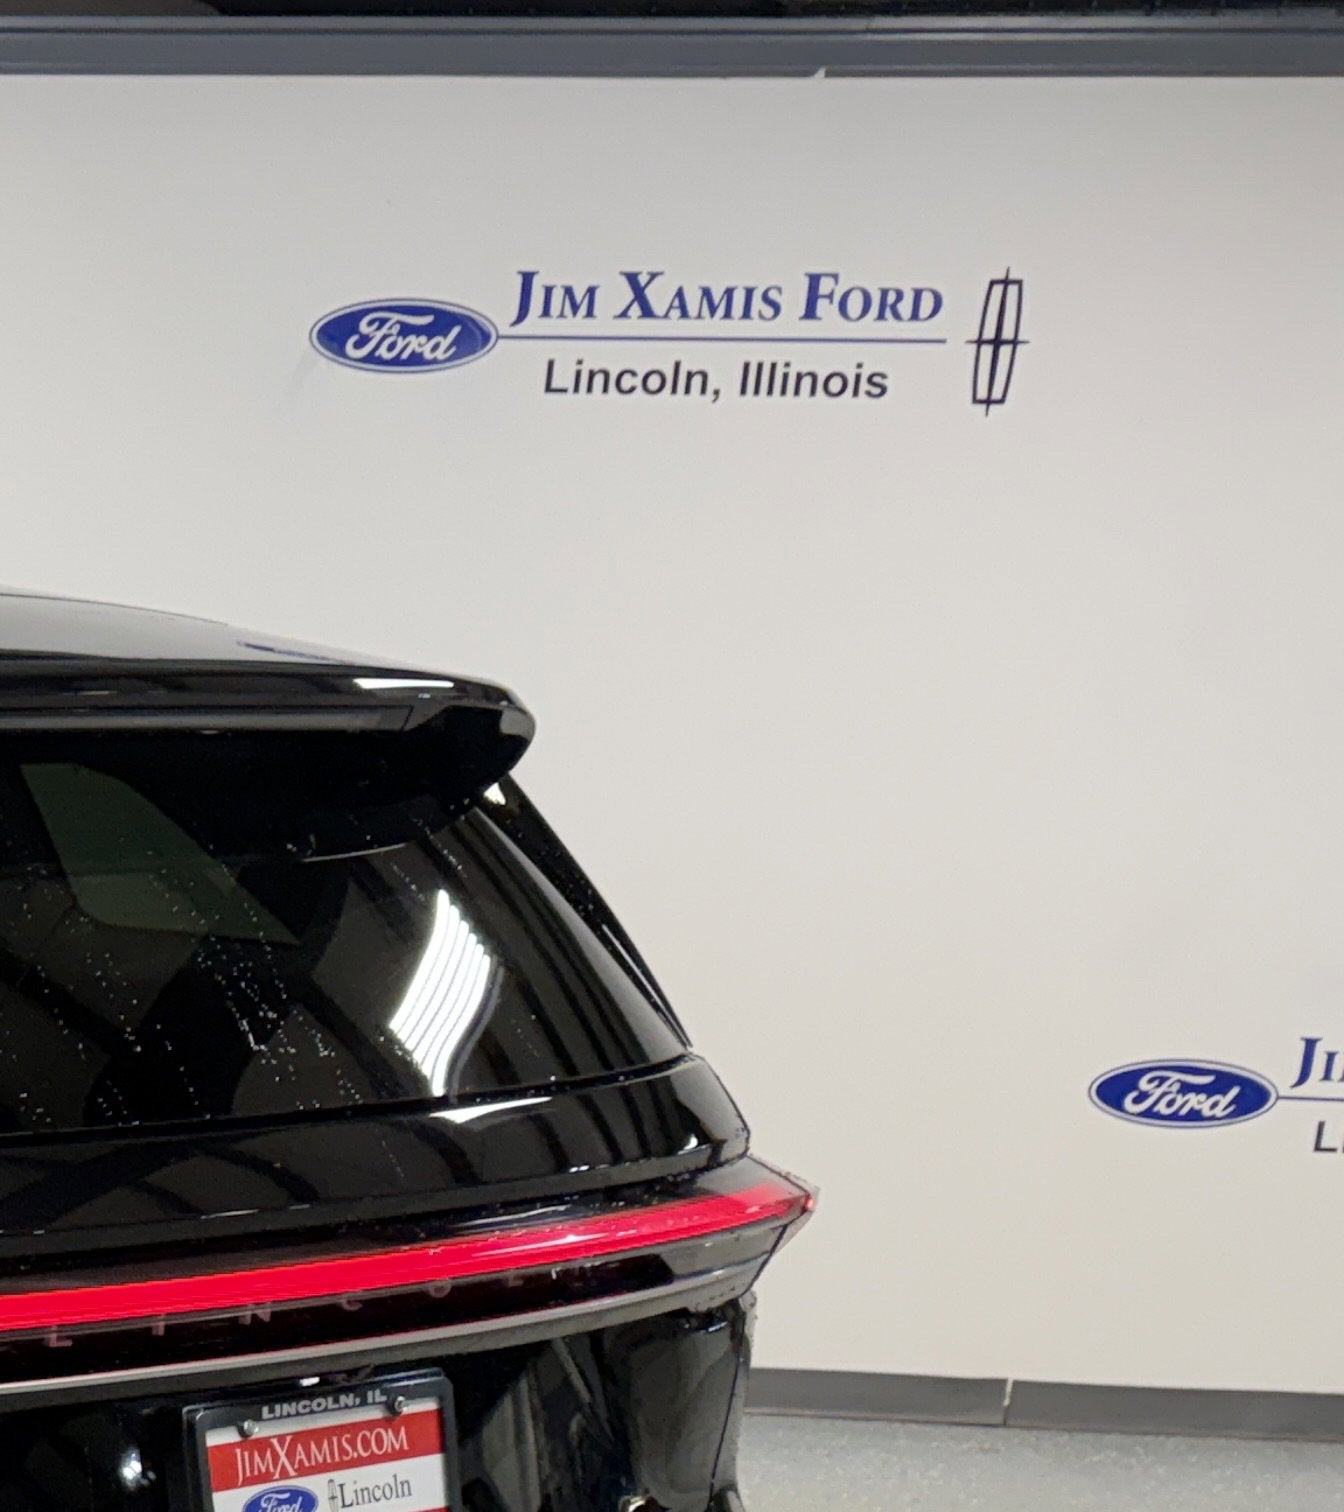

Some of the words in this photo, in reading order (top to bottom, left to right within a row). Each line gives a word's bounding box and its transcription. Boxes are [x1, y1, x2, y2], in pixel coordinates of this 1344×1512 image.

[510, 271, 597, 327] JIM
[614, 271, 783, 322] XAMIS
[799, 273, 945, 324] FORD
[344, 313, 459, 362] Ford
[544, 359, 722, 402] Lincoln,
[740, 361, 890, 399] Illinois
[1290, 1036, 1344, 1089] JI
[1122, 1070, 1241, 1119] Ford
[262, 1392, 361, 1420] LINCOLN,
[367, 1389, 387, 1403] IL
[338, 1474, 412, 1509] Lincoln
